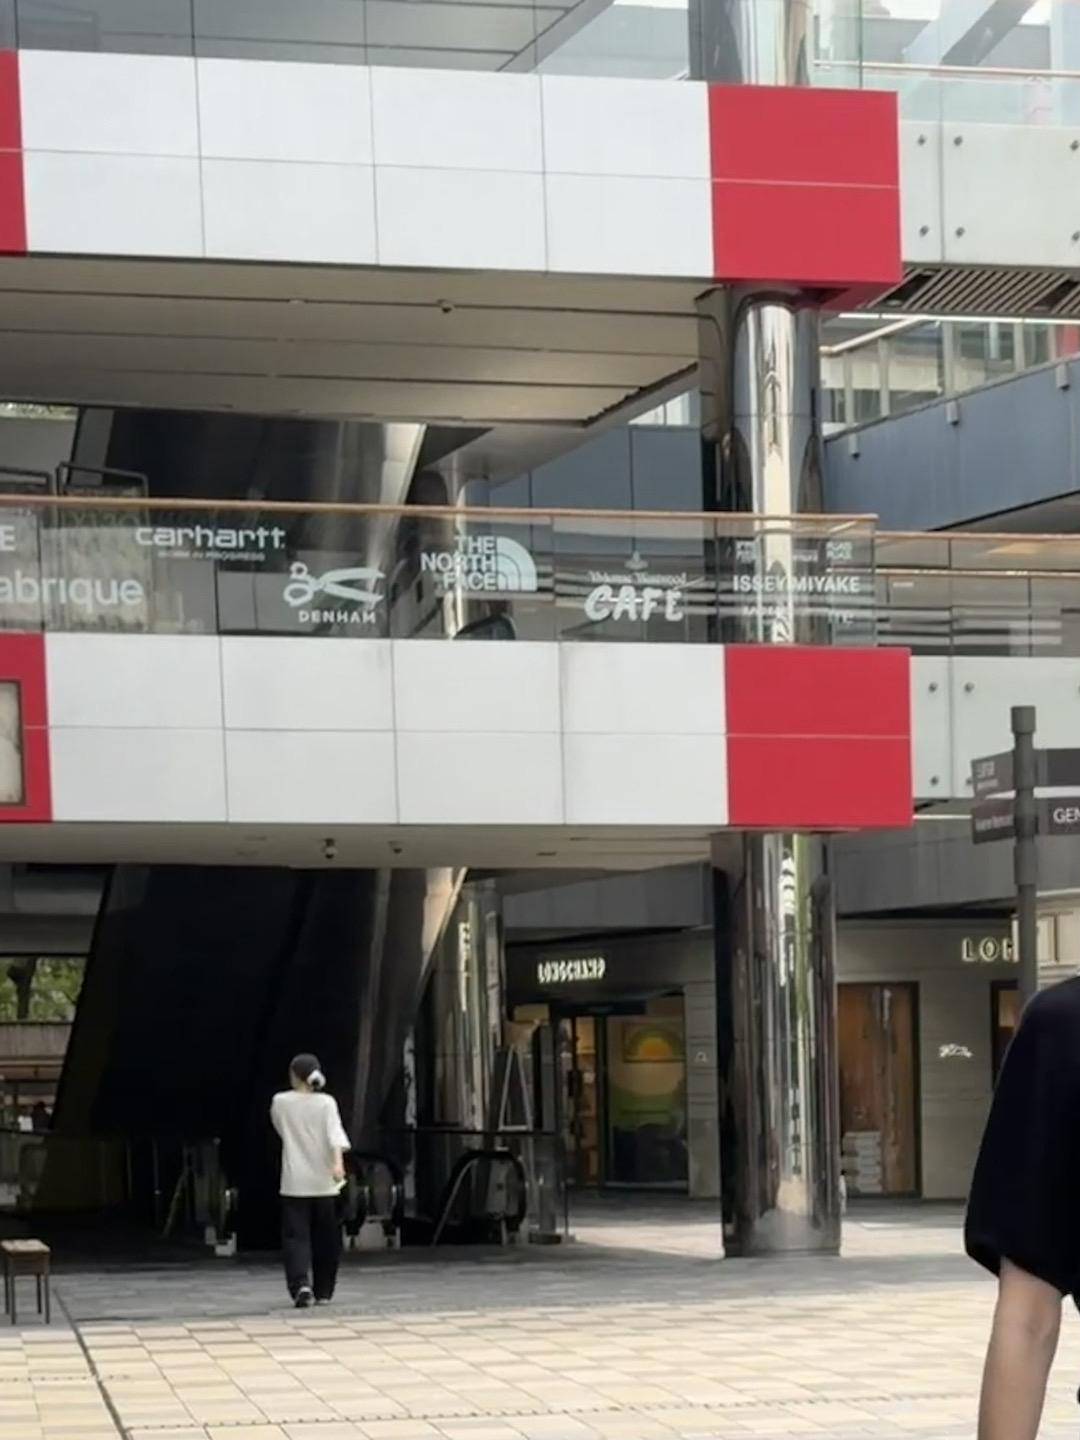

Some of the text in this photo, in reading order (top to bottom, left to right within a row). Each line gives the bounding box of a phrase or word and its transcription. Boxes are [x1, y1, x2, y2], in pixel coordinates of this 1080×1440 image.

[136, 525, 285, 548] carhartt
[454, 536, 496, 555] THE
[420, 552, 496, 572] NORTH
[443, 572, 496, 591] FACE
[733, 575, 861, 593] ISSEY MIYAKE
[299, 611, 377, 624] DENHAM
